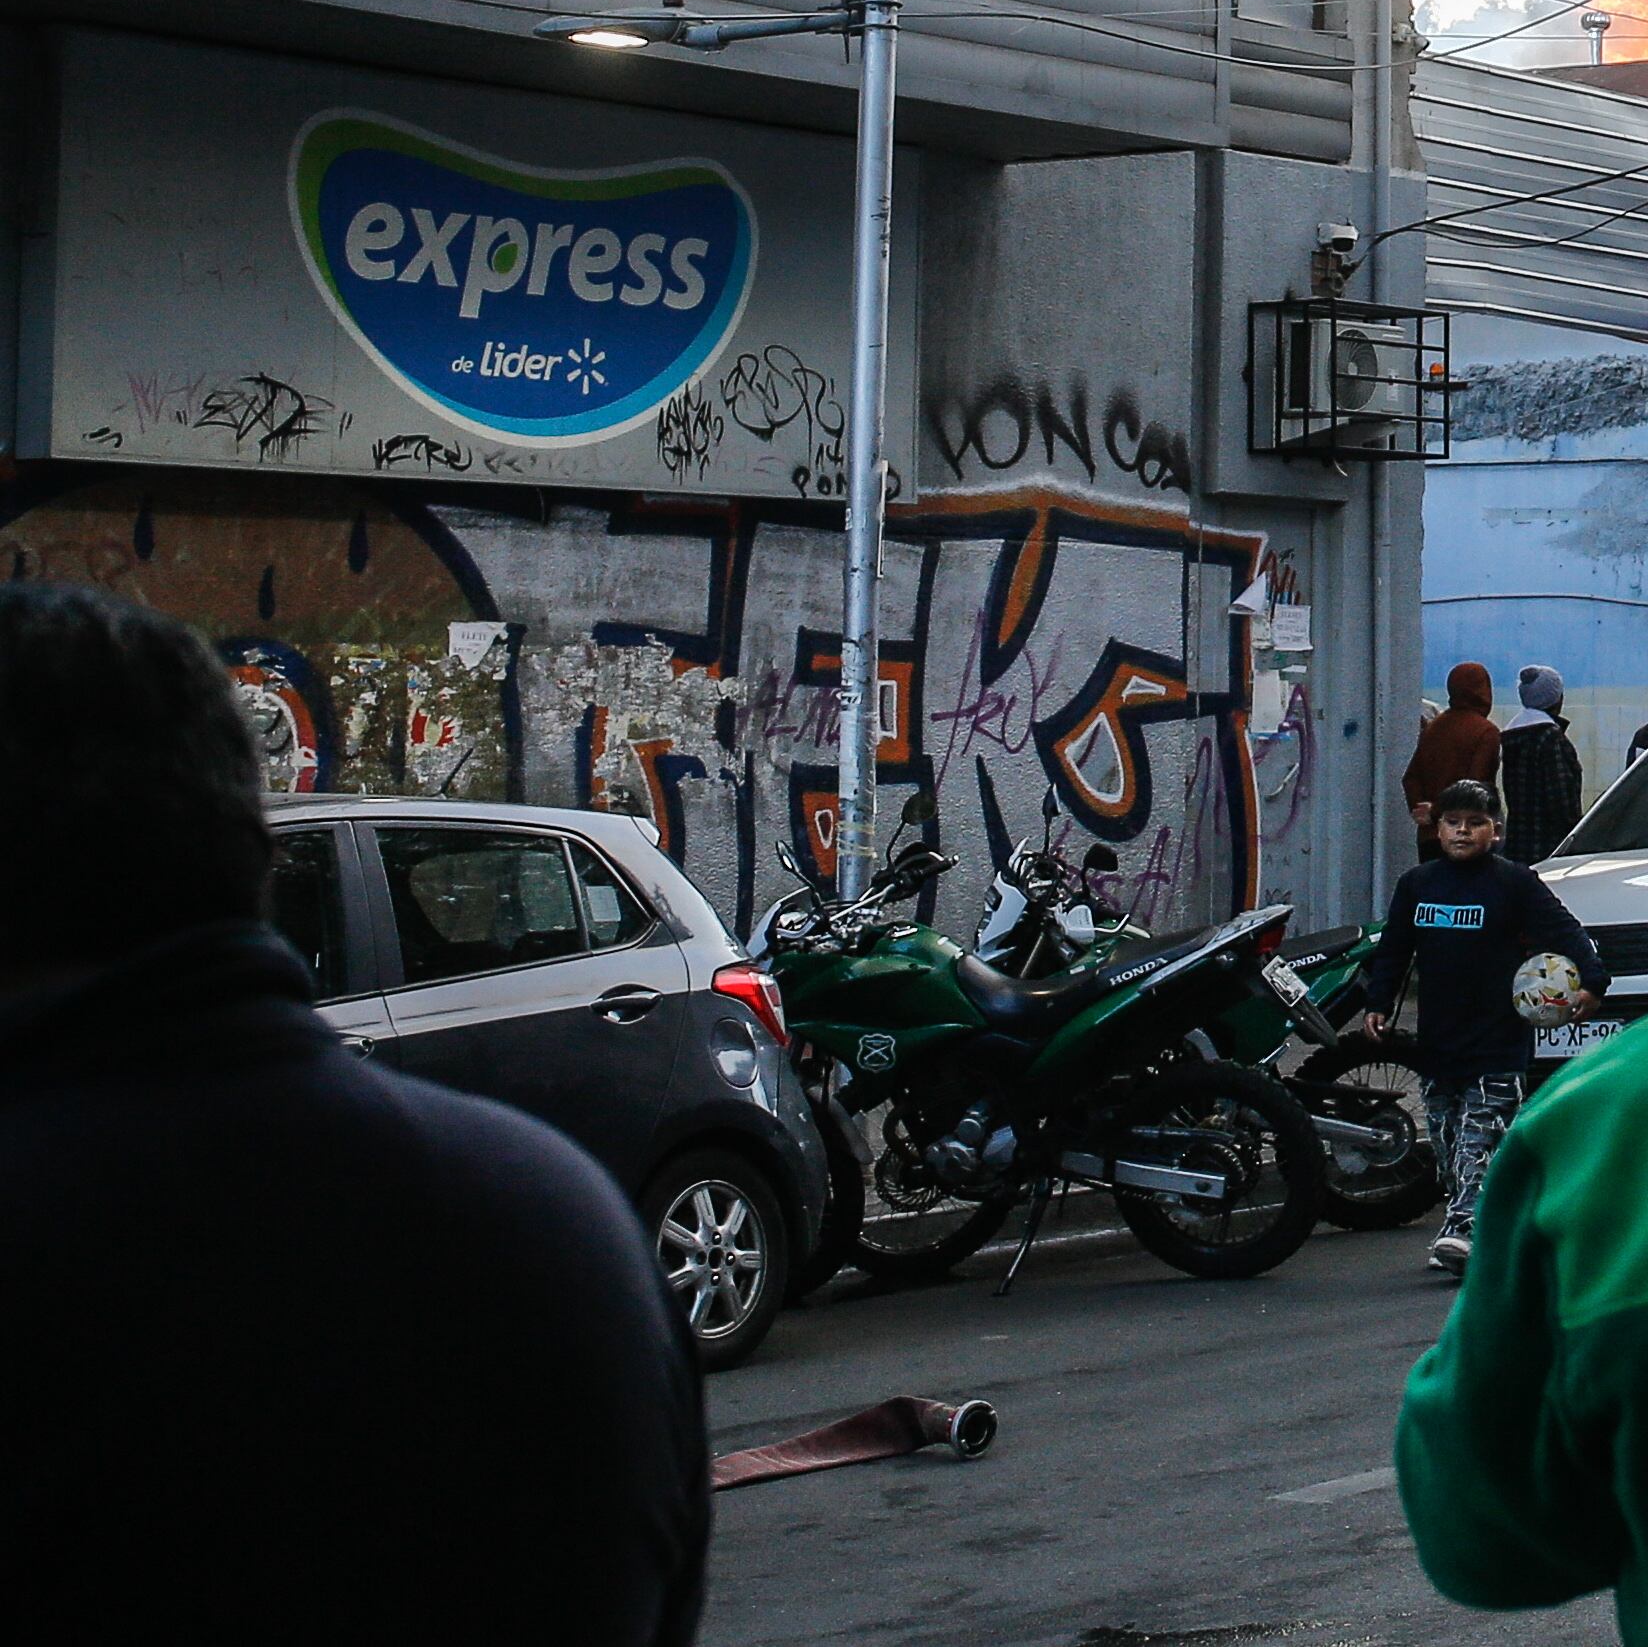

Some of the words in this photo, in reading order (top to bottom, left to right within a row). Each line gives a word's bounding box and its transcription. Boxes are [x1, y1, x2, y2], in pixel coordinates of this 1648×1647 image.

[345, 202, 709, 319] express
[452, 355, 474, 374] de
[1416, 906, 1482, 927] PUMA
[1109, 956, 1169, 987] HONDA
[1287, 953, 1328, 969] ONDA
